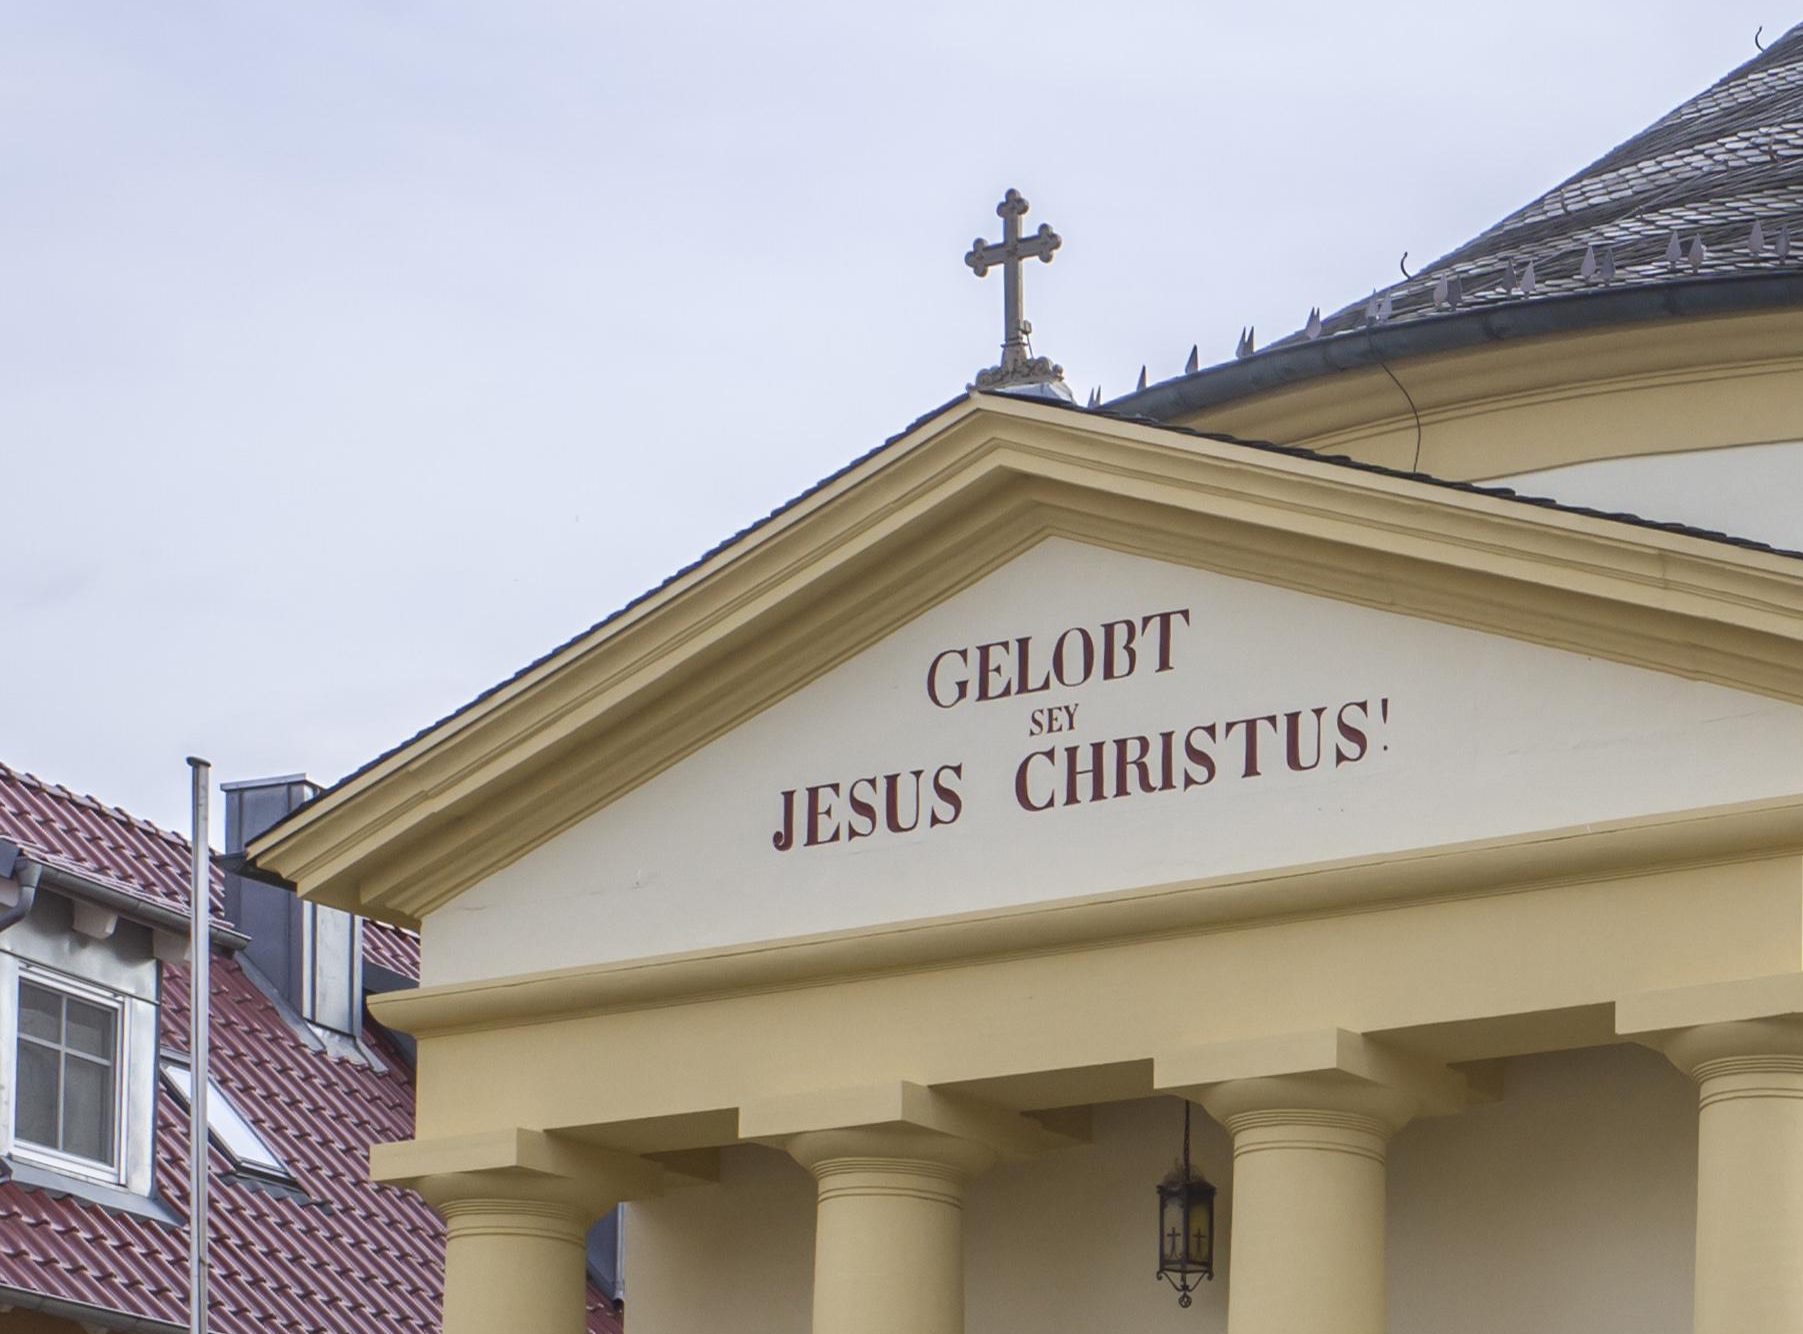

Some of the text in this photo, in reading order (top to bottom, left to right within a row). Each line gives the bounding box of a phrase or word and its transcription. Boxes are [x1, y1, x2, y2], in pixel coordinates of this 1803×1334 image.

[926, 608, 1191, 710] GELOBT
[1029, 703, 1080, 737] SEY
[772, 698, 1391, 853] JESUS CHRISTUS!
